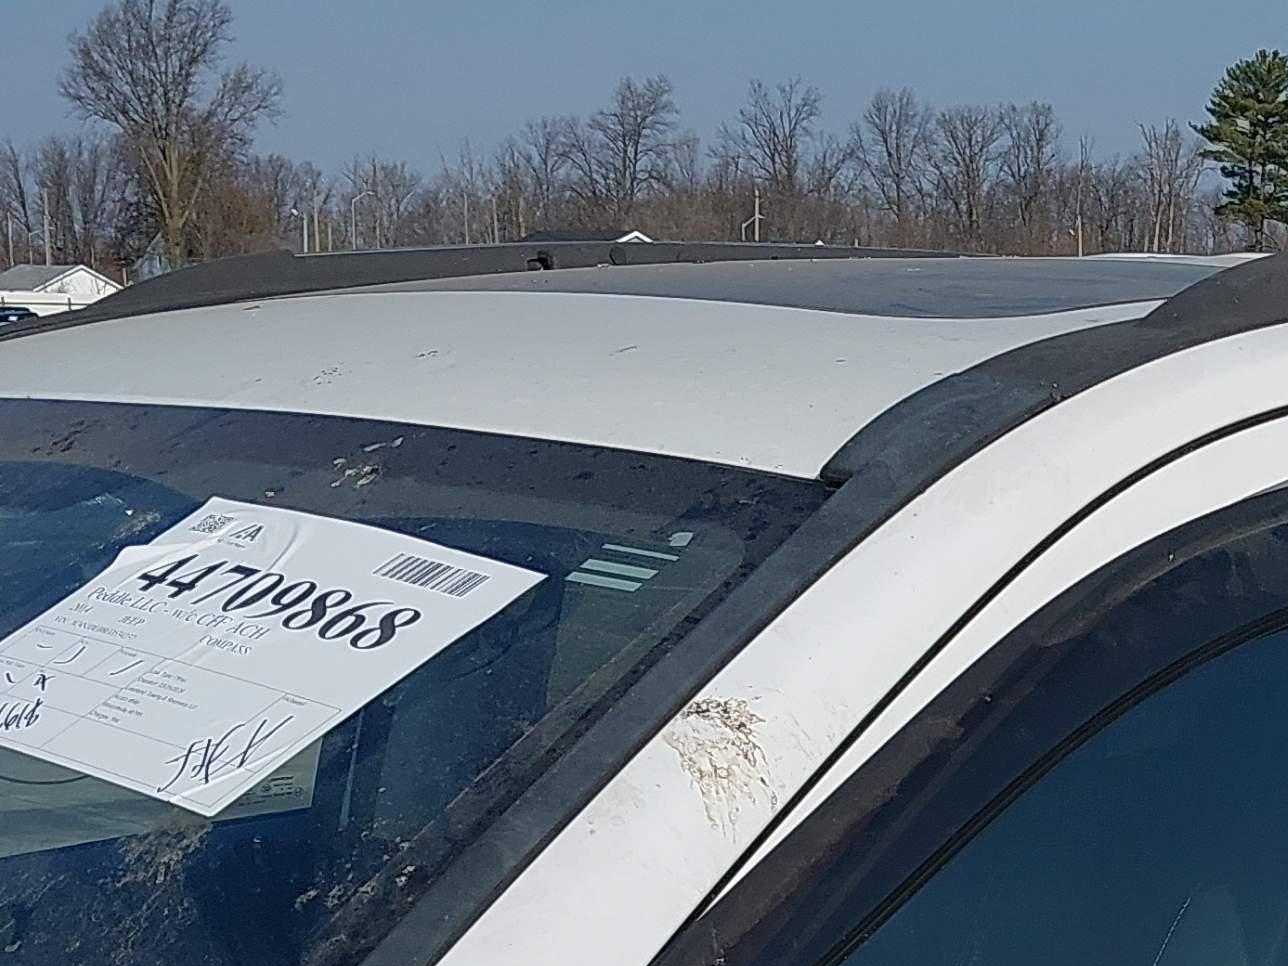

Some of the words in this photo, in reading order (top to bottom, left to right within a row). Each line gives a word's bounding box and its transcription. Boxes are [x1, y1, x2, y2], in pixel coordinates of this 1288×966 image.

[88, 586, 133, 606] Peddle
[130, 597, 167, 613] LLC
[228, 619, 272, 640] ACH
[137, 553, 422, 650] 44709868
[199, 635, 253, 655] COMPASS
